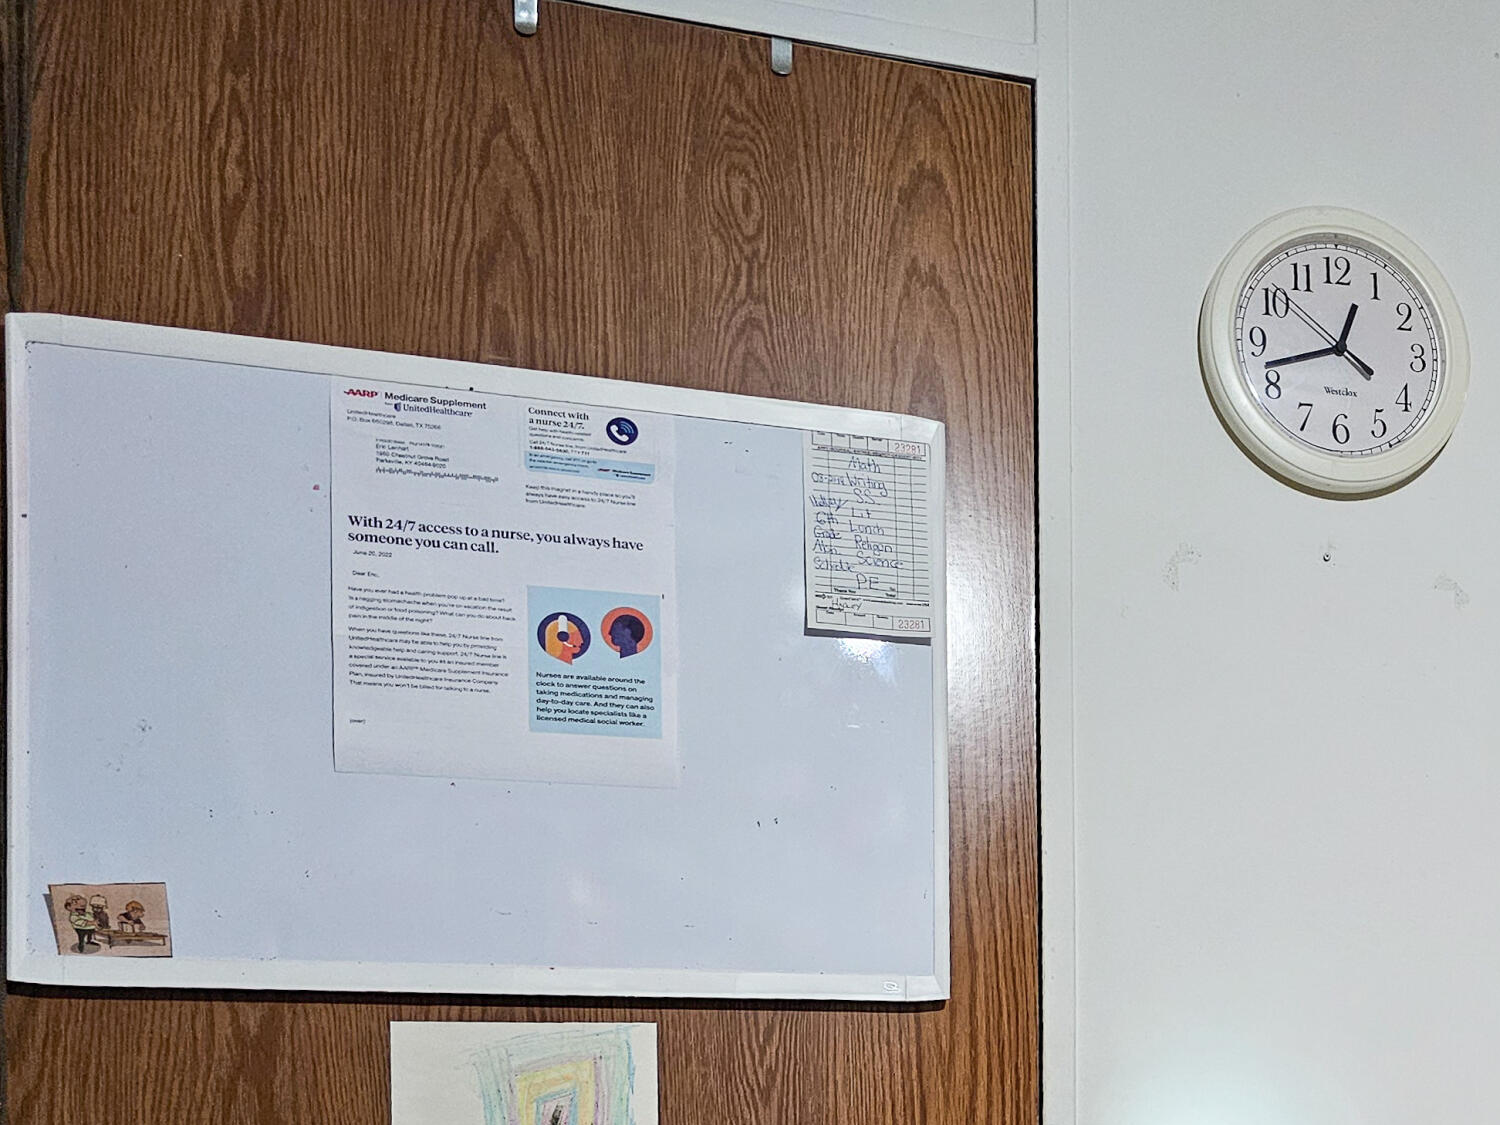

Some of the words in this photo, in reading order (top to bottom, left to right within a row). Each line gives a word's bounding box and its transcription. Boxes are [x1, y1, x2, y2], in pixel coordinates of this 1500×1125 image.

[1290, 262, 1315, 293] 11
[1322, 256, 1352, 286] 12
[1370, 272, 1381, 300] 1
[1262, 287, 1290, 318] 10
[1395, 302, 1413, 332] 2
[1249, 326, 1267, 357] 9
[1409, 343, 1427, 373] 3
[344, 388, 378, 398] AARP
[384, 392, 429, 403] Medicare
[430, 396, 487, 410] Supplement
[1265, 369, 1282, 400] 8
[1323, 385, 1358, 398] Westclox
[1395, 382, 1412, 412] 4
[403, 402, 473, 417] UnitedHealthcare
[528, 407, 565, 418] Connect
[568, 411, 589, 421] with
[536, 418, 561, 427] nurse
[1297, 402, 1314, 432] 7
[1370, 408, 1387, 439] 5
[1332, 413, 1350, 445] 6
[848, 456, 881, 473] Math
[348, 515, 383, 529] With
[385, 518, 416, 532] 24/7
[418, 522, 462, 535] access
[465, 526, 478, 537] to
[481, 529, 489, 538] a
[491, 529, 534, 542] nurse,
[536, 532, 561, 544] you
[563, 534, 610, 549] always
[612, 537, 644, 551] have
[348, 531, 413, 546] someone
[415, 538, 440, 550] you
[443, 540, 468, 550] can
[470, 541, 499, 553] call.
[849, 520, 884, 536] Lunch
[898, 619, 925, 630] 23281
